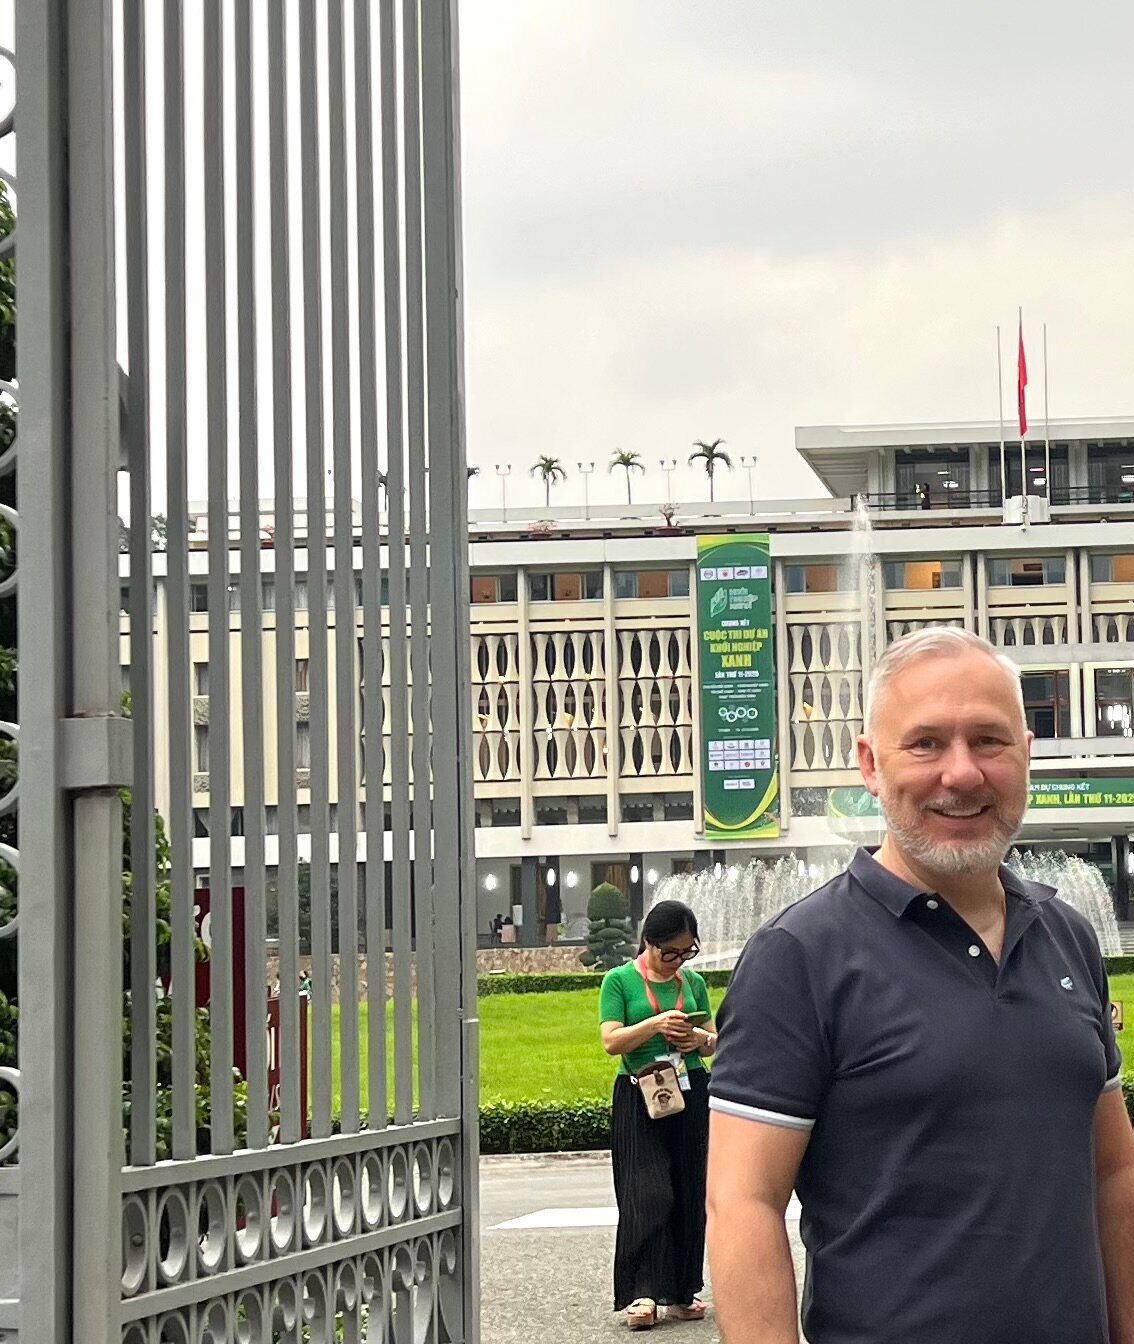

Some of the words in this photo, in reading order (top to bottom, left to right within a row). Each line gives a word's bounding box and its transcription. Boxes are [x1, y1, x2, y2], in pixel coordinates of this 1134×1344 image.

[703, 630, 727, 642] CUỘC
[728, 629, 742, 639] THI
[721, 654, 752, 668] XANH
[1076, 782, 1090, 790] KẾT
[1064, 791, 1080, 804] LẦN
[1082, 792, 1102, 804] THỨ
